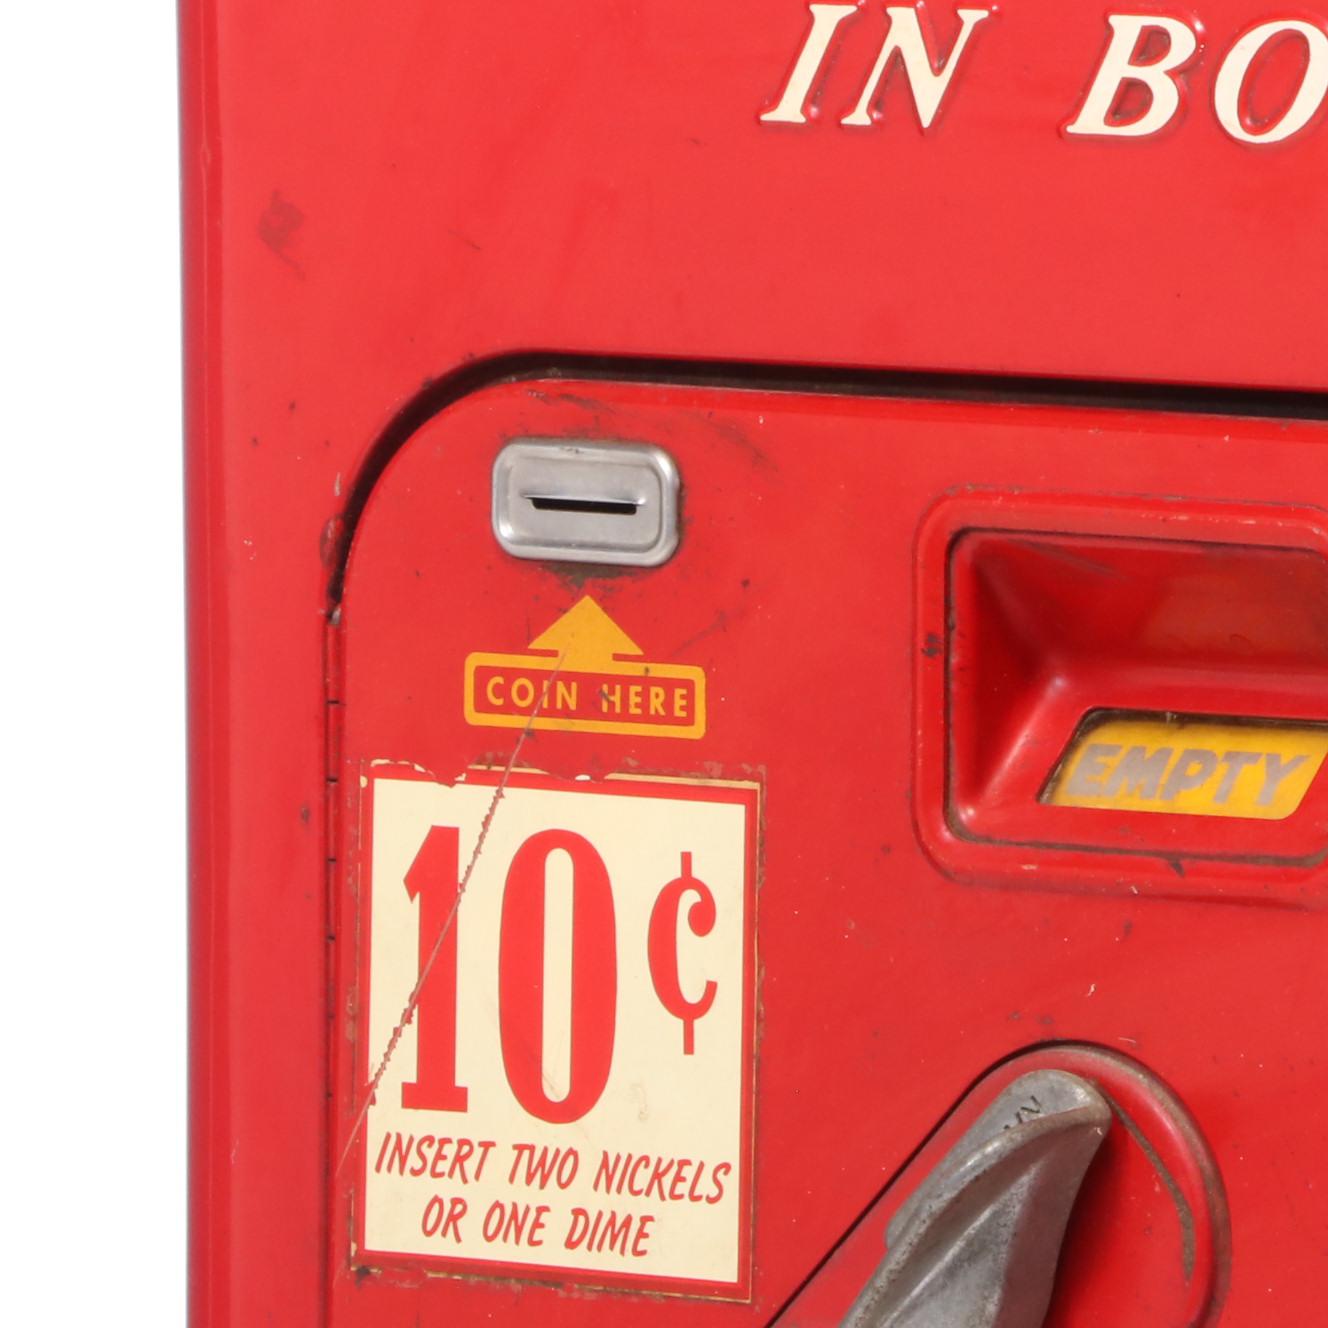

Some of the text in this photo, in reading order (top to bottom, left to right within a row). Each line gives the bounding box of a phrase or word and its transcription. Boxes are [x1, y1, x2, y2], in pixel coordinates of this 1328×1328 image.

[761, 4, 989, 129] IN
[486, 676, 688, 718] COIN HERE
[1065, 742, 1310, 806] EMPTY
[375, 1132, 732, 1205] INSERT TWO NICKELS
[421, 1194, 655, 1257] OR ONE DIME
